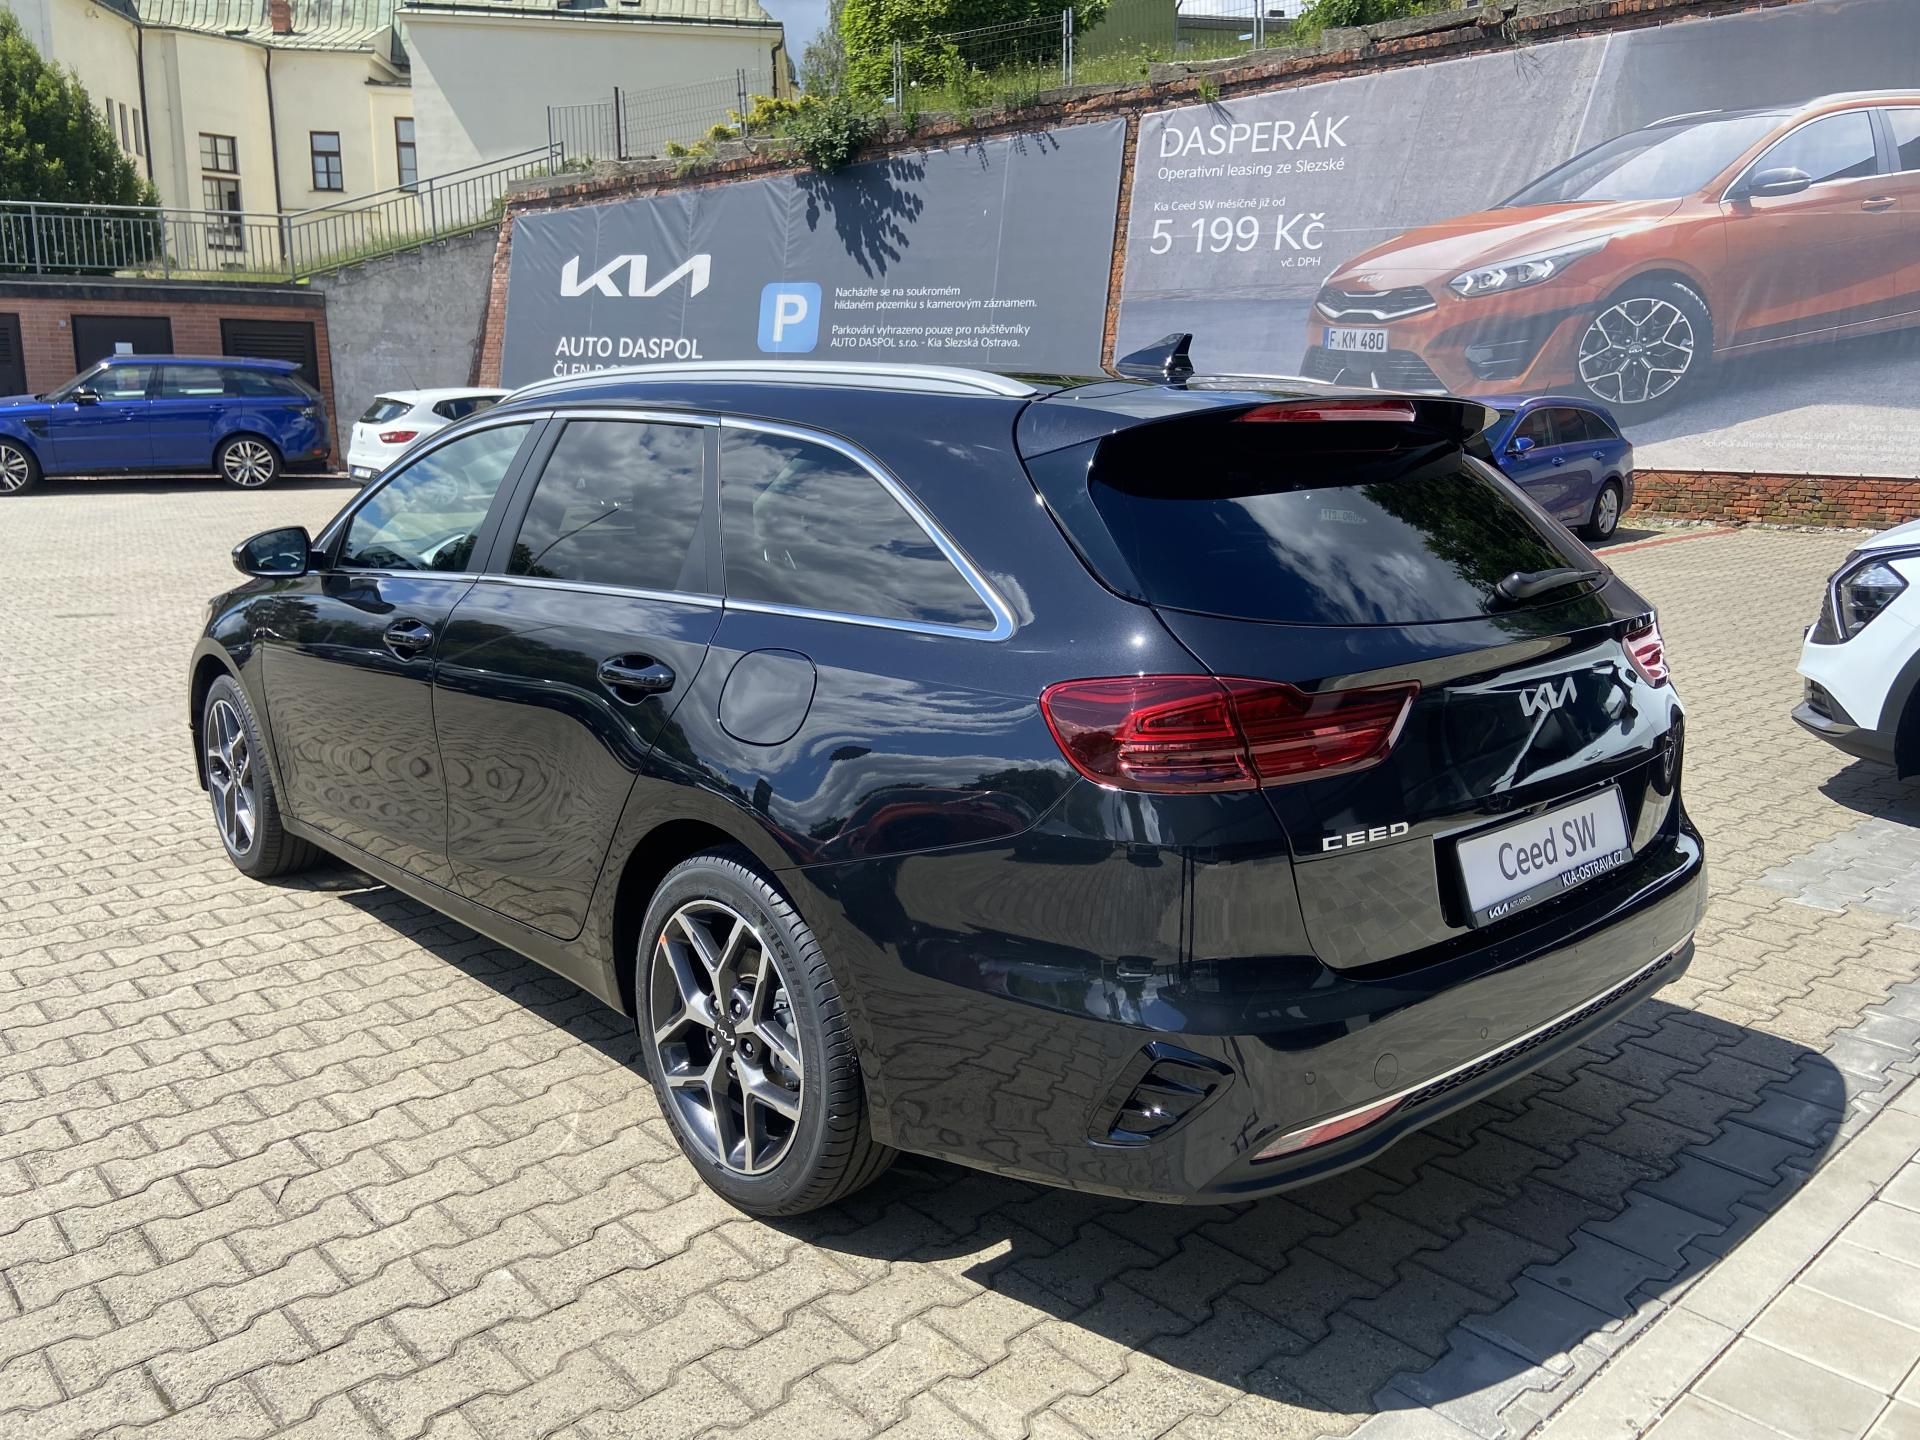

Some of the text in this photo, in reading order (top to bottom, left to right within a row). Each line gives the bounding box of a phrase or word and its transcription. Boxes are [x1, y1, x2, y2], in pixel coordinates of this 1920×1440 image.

[1159, 111, 1350, 158] DASPERÁK
[1158, 157, 1345, 182] Operativní leasing ze Slezské
[1154, 197, 1286, 211] Kia Ceed SW měsíčně již od
[1150, 212, 1326, 255] 5 199 Kč
[1281, 256, 1321, 267] vč. DPH
[560, 254, 711, 298] KIA
[835, 286, 960, 298] Nacházíte se na soukromém
[834, 298, 1038, 312] hlídaném pozemku s kamerovým záznamem.
[772, 294, 808, 342] P
[830, 338, 857, 348] AUTO
[859, 338, 896, 348] DASPOL
[898, 339, 919, 348] s.r.o.
[927, 337, 942, 348] Kia
[944, 337, 979, 348] Slezská
[981, 338, 1021, 348] Ostrava.
[831, 324, 1031, 337] Parkování vyhrazeno pouze pro návštěvníky
[1360, 332, 1384, 350] 480
[555, 336, 703, 359] AUTO DASPOL
[1518, 676, 1578, 717] KIA
[1322, 821, 1409, 852] CEED
[1498, 812, 1597, 881] Ceed SW
[1561, 850, 1625, 888] KIA-OSTRAVA.CZ
[1488, 902, 1509, 919] KIA
